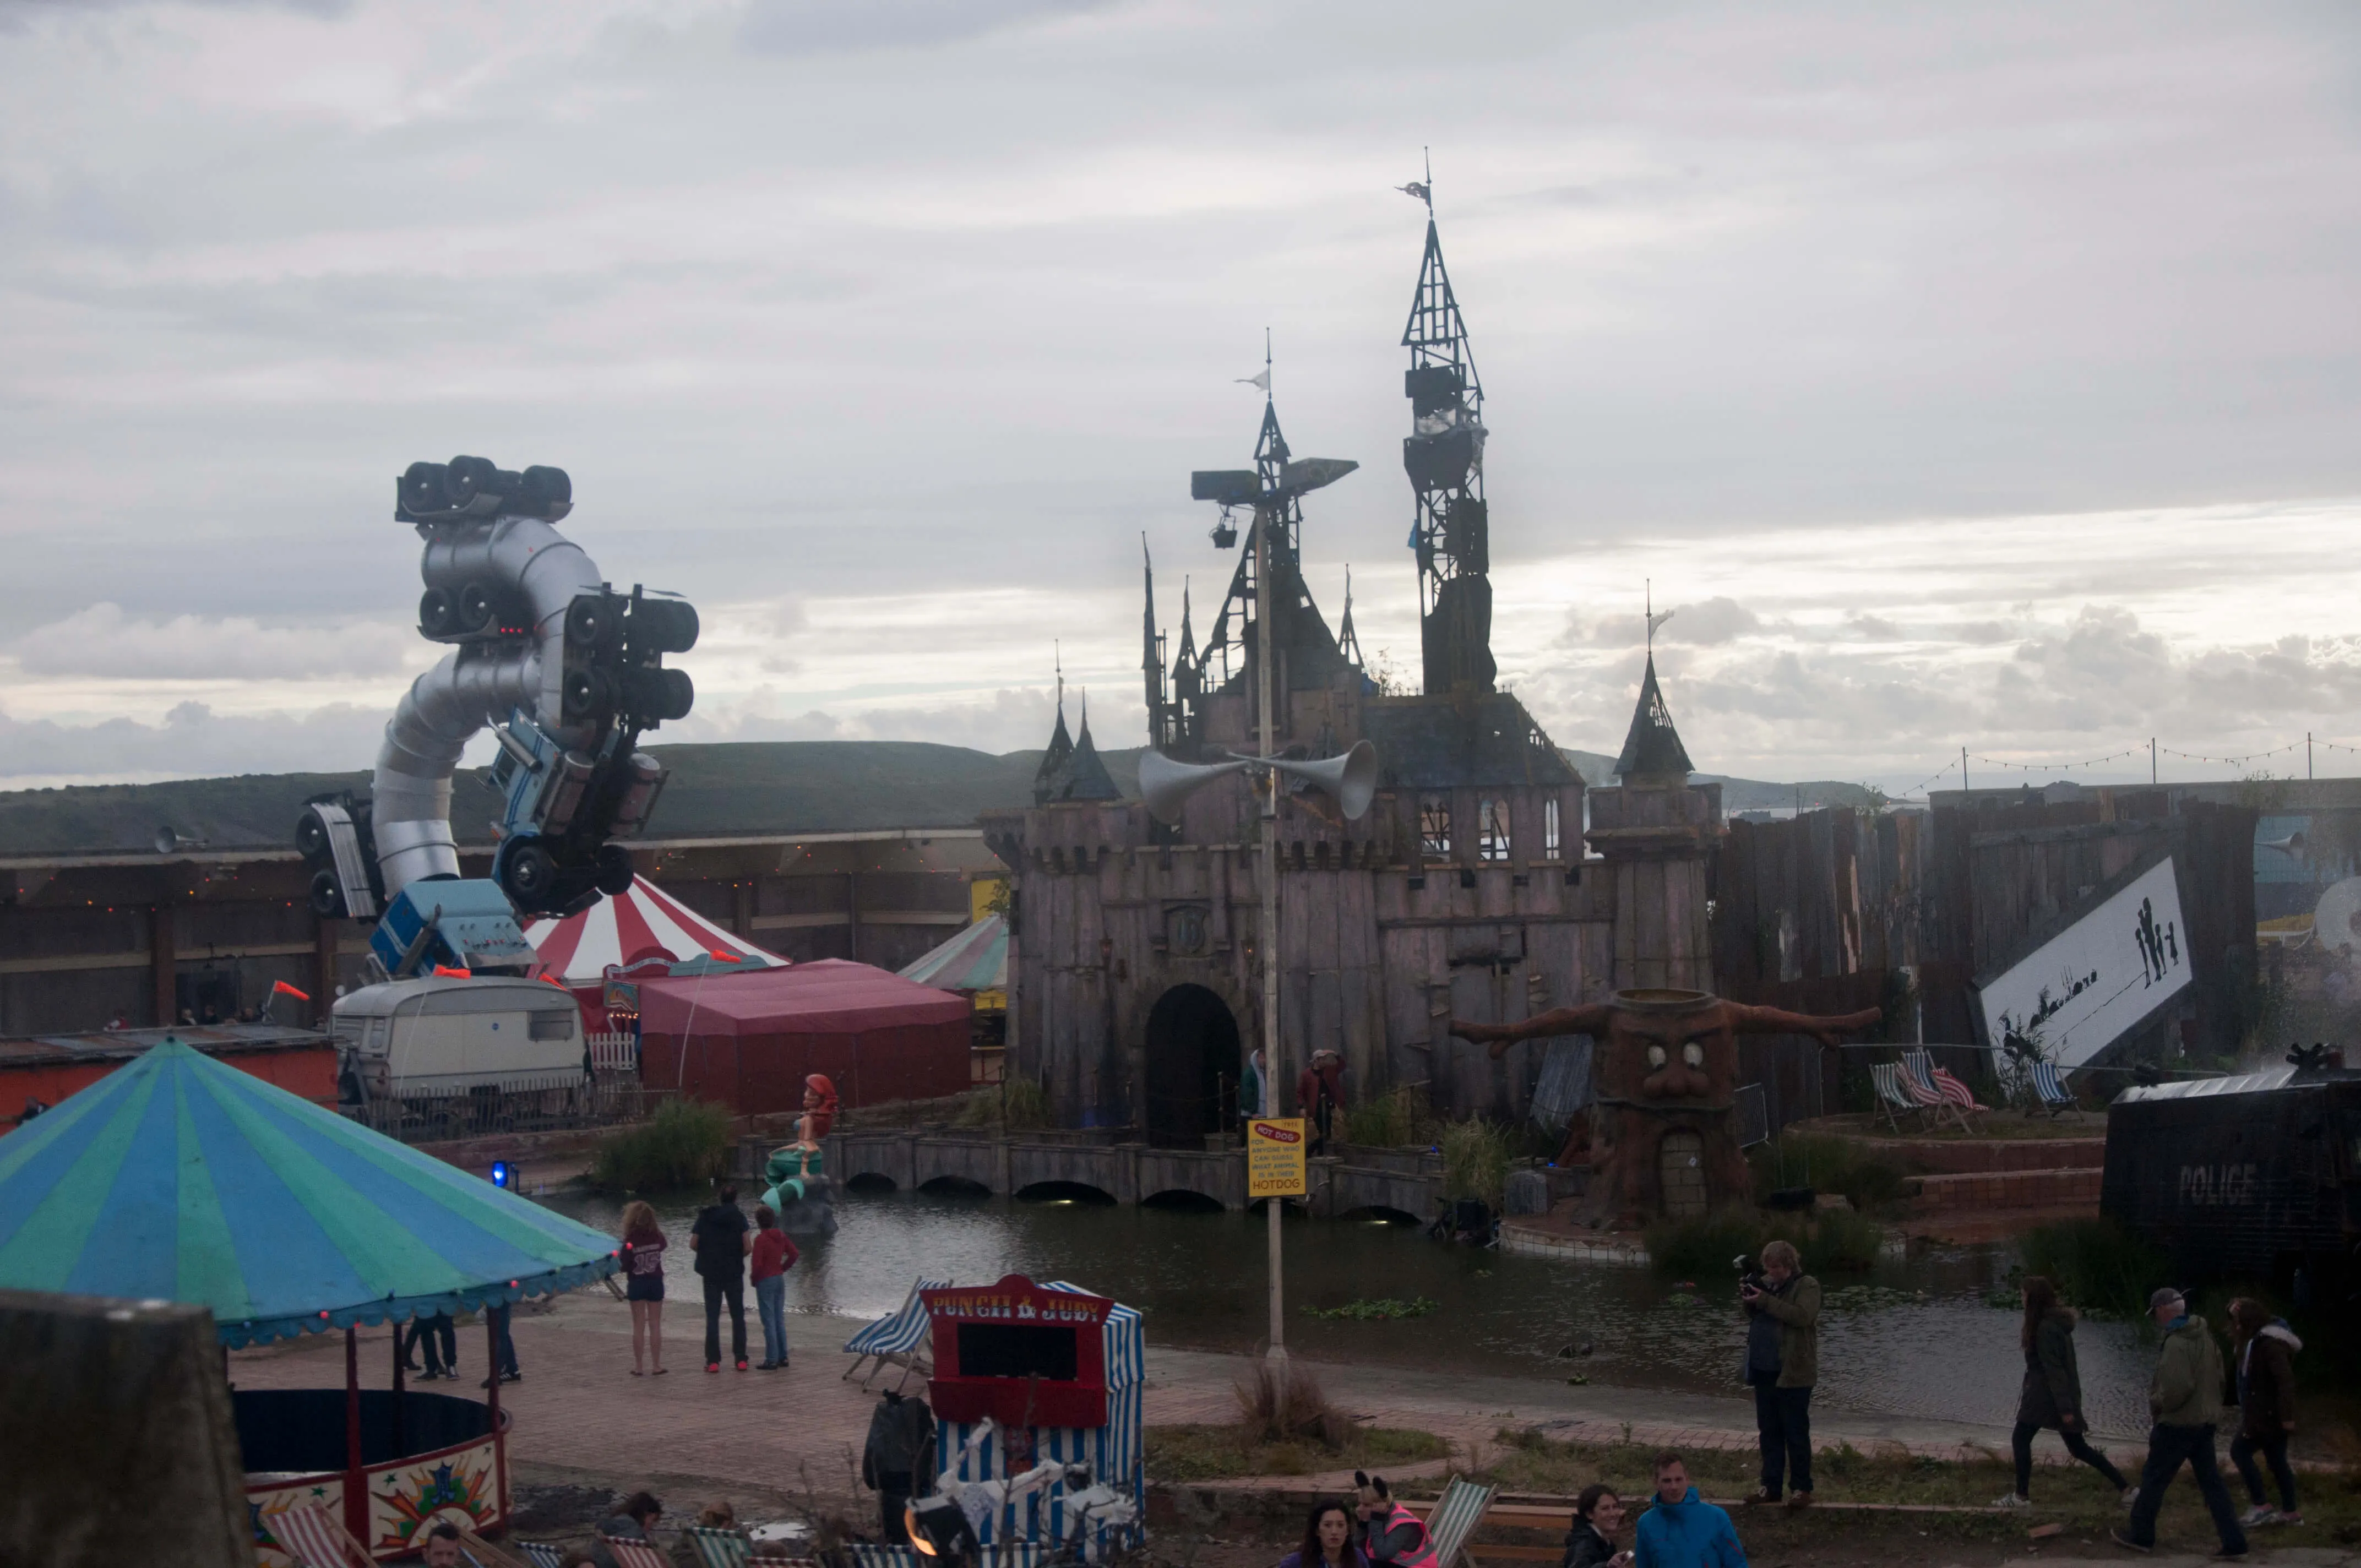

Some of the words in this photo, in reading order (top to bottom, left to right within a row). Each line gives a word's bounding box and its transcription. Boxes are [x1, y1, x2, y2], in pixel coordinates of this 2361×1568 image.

[1258, 1125, 1273, 1136] HOT
[1275, 1131, 1294, 1141] DOG
[1253, 1179, 1299, 1189] HOTDOG
[2179, 1164, 2257, 1205] POLICE
[932, 1295, 1012, 1318] PUNCH
[1018, 1295, 1036, 1319] &
[1042, 1298, 1100, 1322] JUDY
